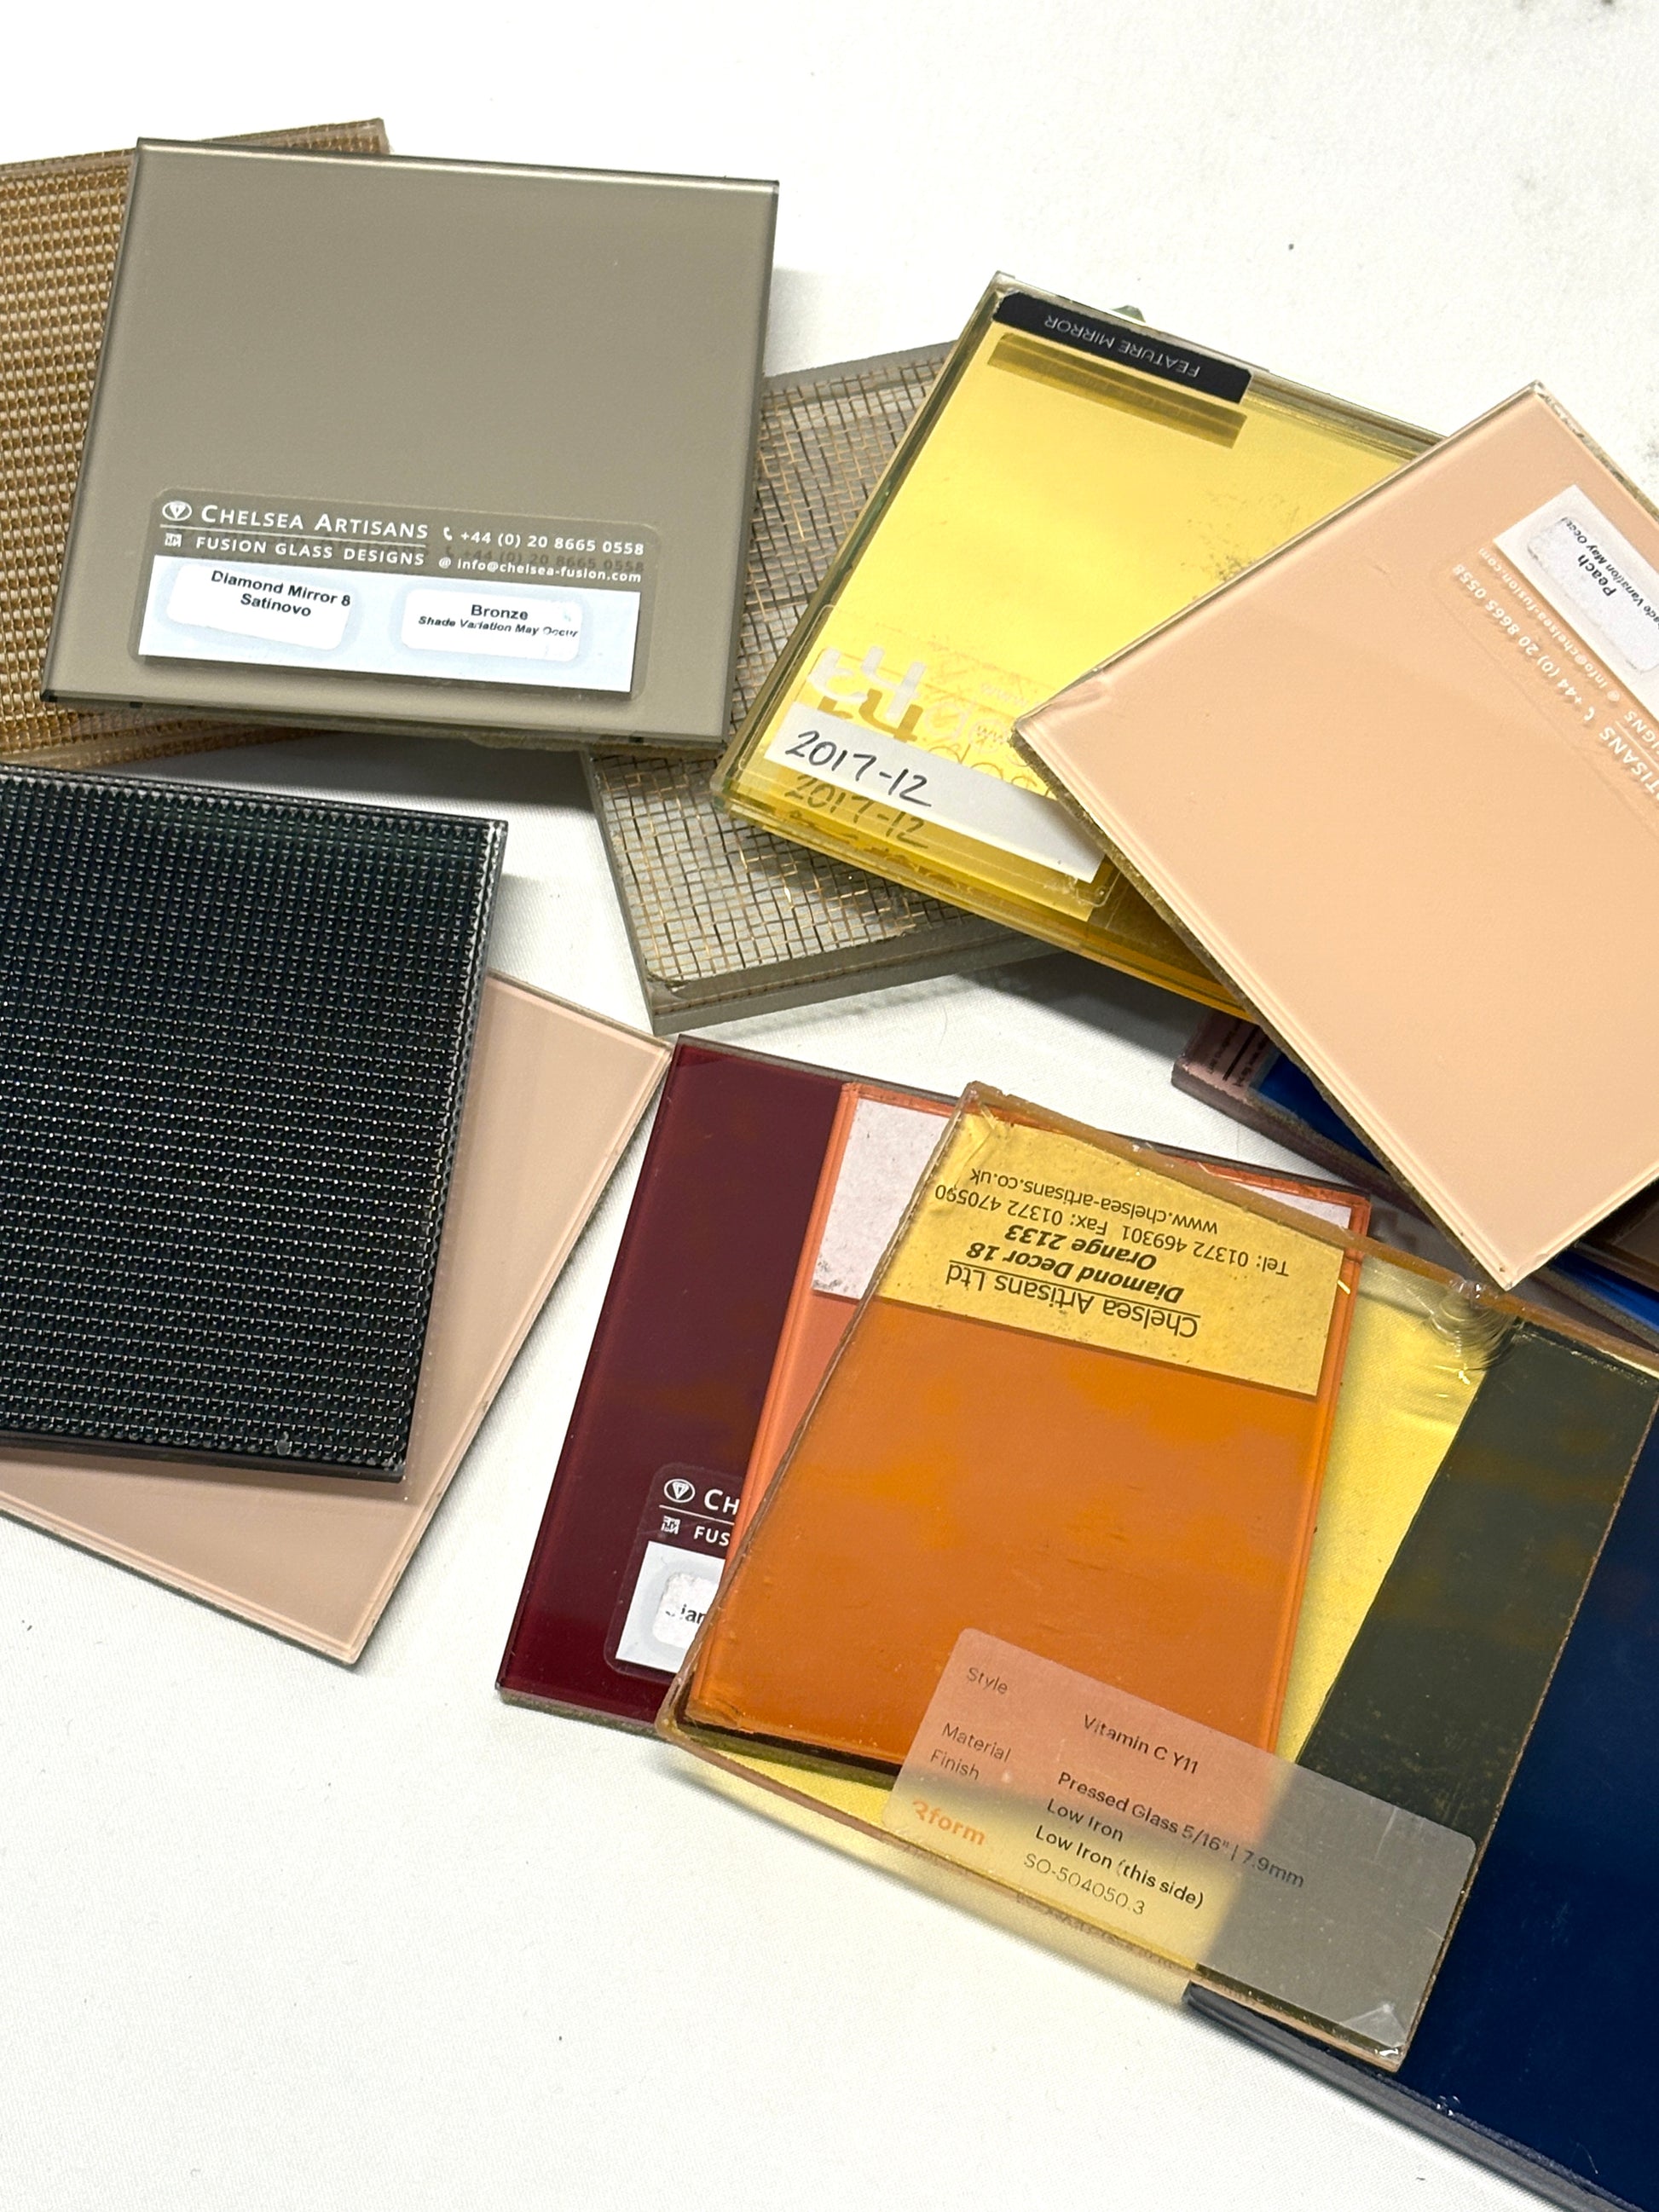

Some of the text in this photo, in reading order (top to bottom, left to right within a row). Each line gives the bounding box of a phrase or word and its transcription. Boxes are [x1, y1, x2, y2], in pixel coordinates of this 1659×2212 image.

[1043, 314, 1201, 378] FEATURE MIRROR
[200, 504, 428, 539] CHELSEA ARTISANS
[196, 536, 425, 566] FUSION GLASS DESIGNS
[460, 531, 644, 556] +44 (0) 20 8665 0558
[1586, 545, 1607, 564] May
[210, 569, 351, 607] Diamond Mirror 8
[458, 558, 642, 583] info@chelsea-fusion.com
[1577, 554, 1617, 597] Peach
[240, 593, 312, 617] Satinovo
[419, 616, 456, 627] Shade
[460, 619, 512, 632] Variation
[515, 624, 540, 636] May
[471, 604, 529, 620] Bronze
[1478, 547, 1607, 690] info@chelsea-fusion.com
[1452, 563, 1582, 705] +44 (0) 20 8665 0558
[784, 730, 932, 807] 2017-12
[1599, 726, 1659, 800] TISANS
[969, 1168, 1218, 1234] www.chelsea-artisans.co.uk
[934, 1184, 1290, 1277] Tel: 01372 469301 Fax: 01372 470590
[1004, 1223, 1158, 1271] Orange 2133
[966, 1241, 1184, 1304] Diamond Decor 18
[946, 1263, 1199, 1337] Chelsea Artisans Ltd
[693, 1525, 730, 1546] FUS
[966, 1666, 1009, 1696] Style
[941, 1722, 1011, 1763] Material
[1082, 1714, 1199, 1775] Vitamin C Y11
[930, 1749, 980, 1781] Finish
[1047, 1799, 1124, 1842] Low Iron
[1058, 1771, 1130, 1813] Pressed
[1130, 1803, 1179, 1834] Glass
[1241, 1849, 1304, 1889] 7.9mm
[1023, 1852, 1146, 1915] SO-504050.3
[1035, 1825, 1205, 1909] Low Iron (this side)
